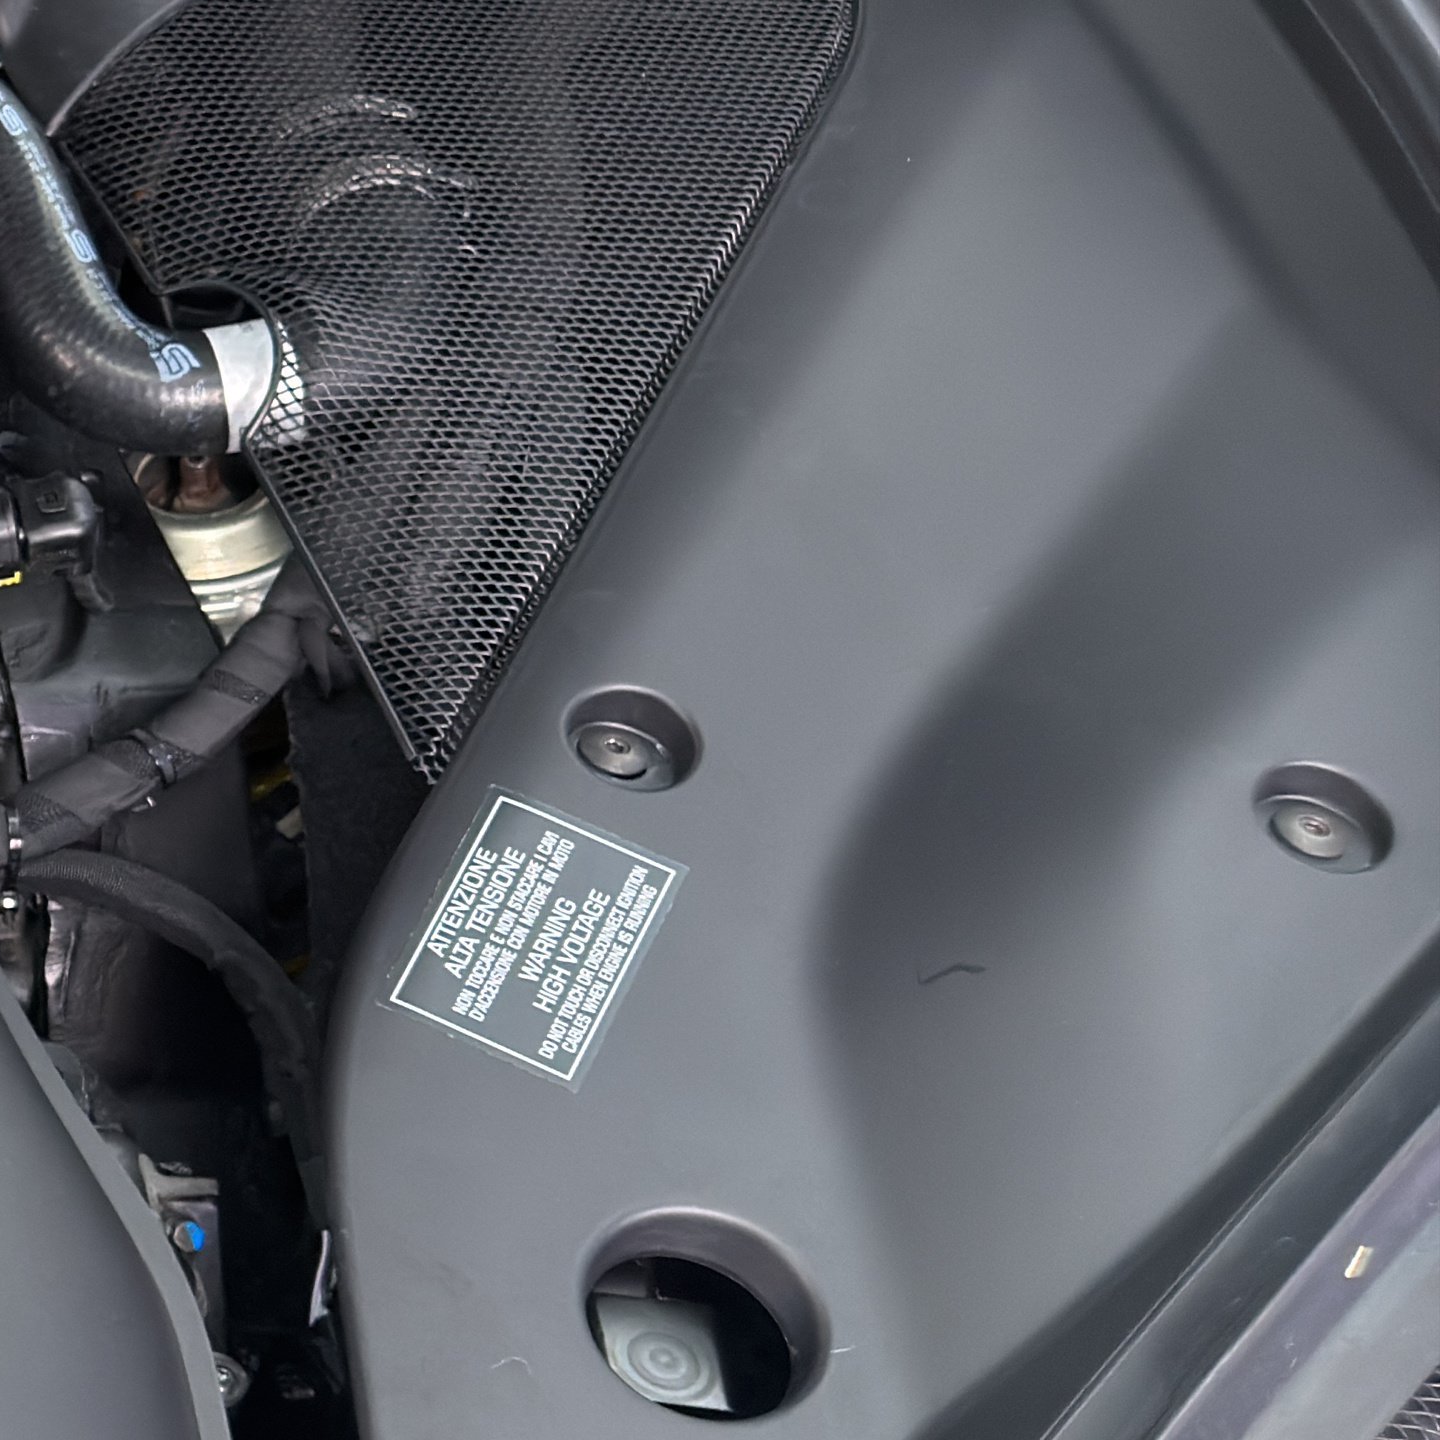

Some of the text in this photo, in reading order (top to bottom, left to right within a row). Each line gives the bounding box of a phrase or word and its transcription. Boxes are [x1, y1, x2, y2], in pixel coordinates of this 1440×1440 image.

[506, 859, 546, 911] STACCARE
[536, 830, 561, 856] CAVI
[423, 846, 498, 958] ATTENZIONE
[441, 845, 527, 978] ALTA TENSIONE
[467, 837, 576, 1022] D'ACCENSIONE CON MOTORE IN MOTO
[488, 933, 506, 944] E
[493, 908, 519, 936] NON
[516, 895, 578, 984] WARNING
[464, 942, 501, 990] TOCCARE
[531, 887, 612, 1013] HIGH VOLTAGE
[536, 864, 650, 1059] DO NOT TOUCH OR DISCONNECT IGNITION
[560, 883, 659, 1053] CABLES WHEN ENGINE IS RUNNING
[450, 987, 476, 1015] NON
